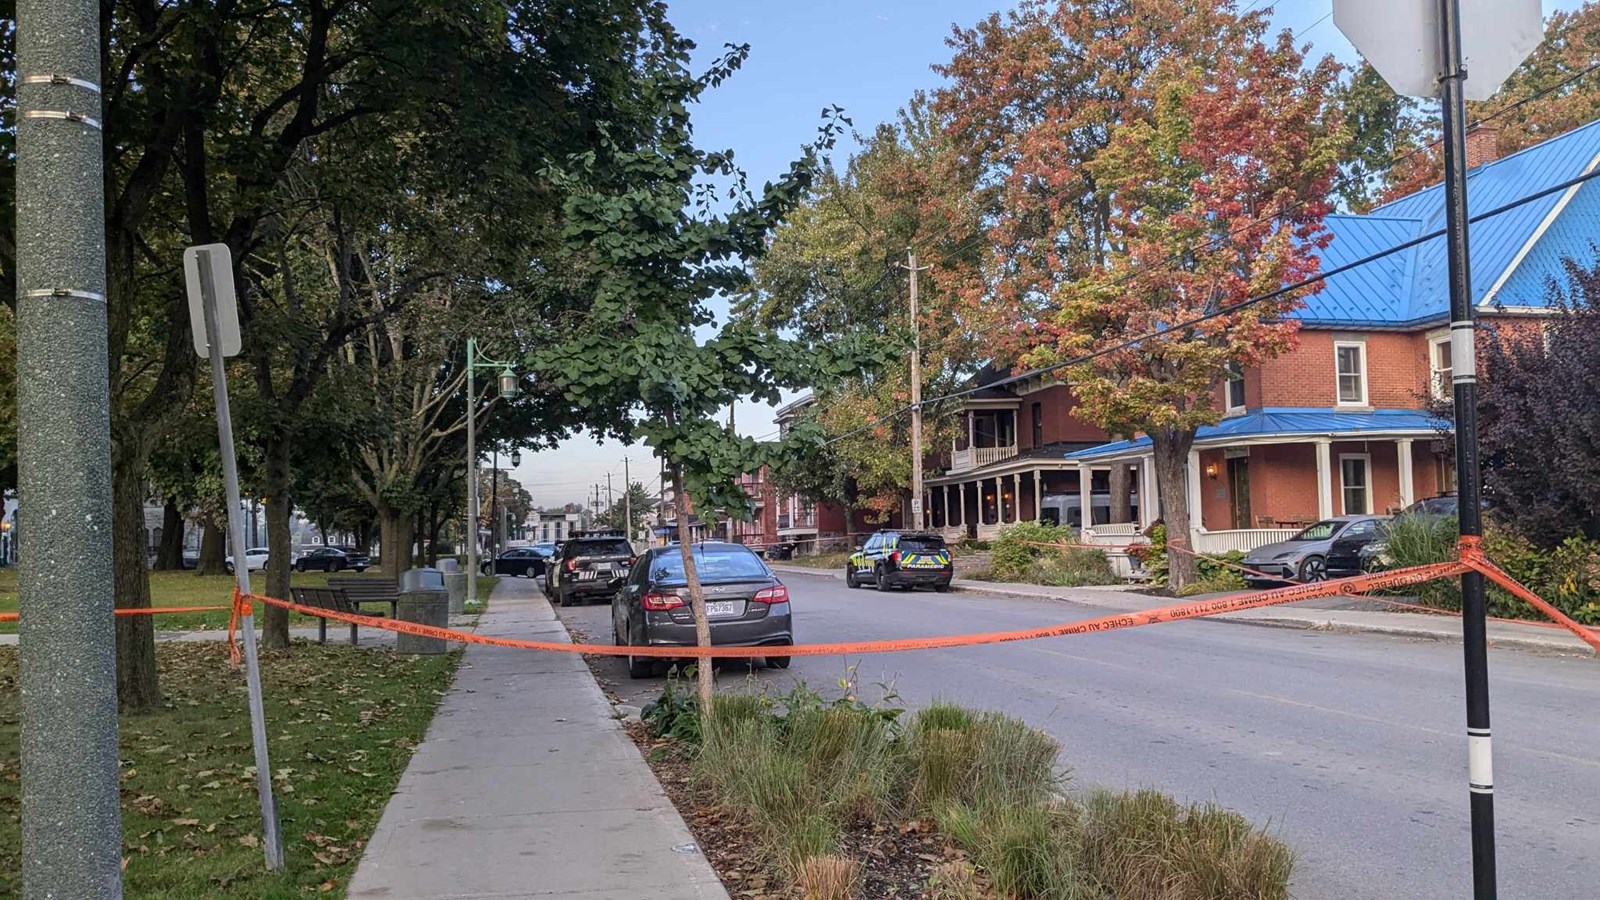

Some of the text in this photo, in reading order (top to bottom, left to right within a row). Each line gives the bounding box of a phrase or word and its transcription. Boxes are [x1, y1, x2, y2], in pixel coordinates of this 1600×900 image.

[1236, 593, 1268, 606] CRIME
[1271, 590, 1285, 599] AU
[1211, 600, 1228, 611] 800
[1229, 599, 1235, 608] 1
[1170, 603, 1209, 618] 711-1800
[1058, 625, 1086, 636] CRIME
[1088, 622, 1100, 631] AU
